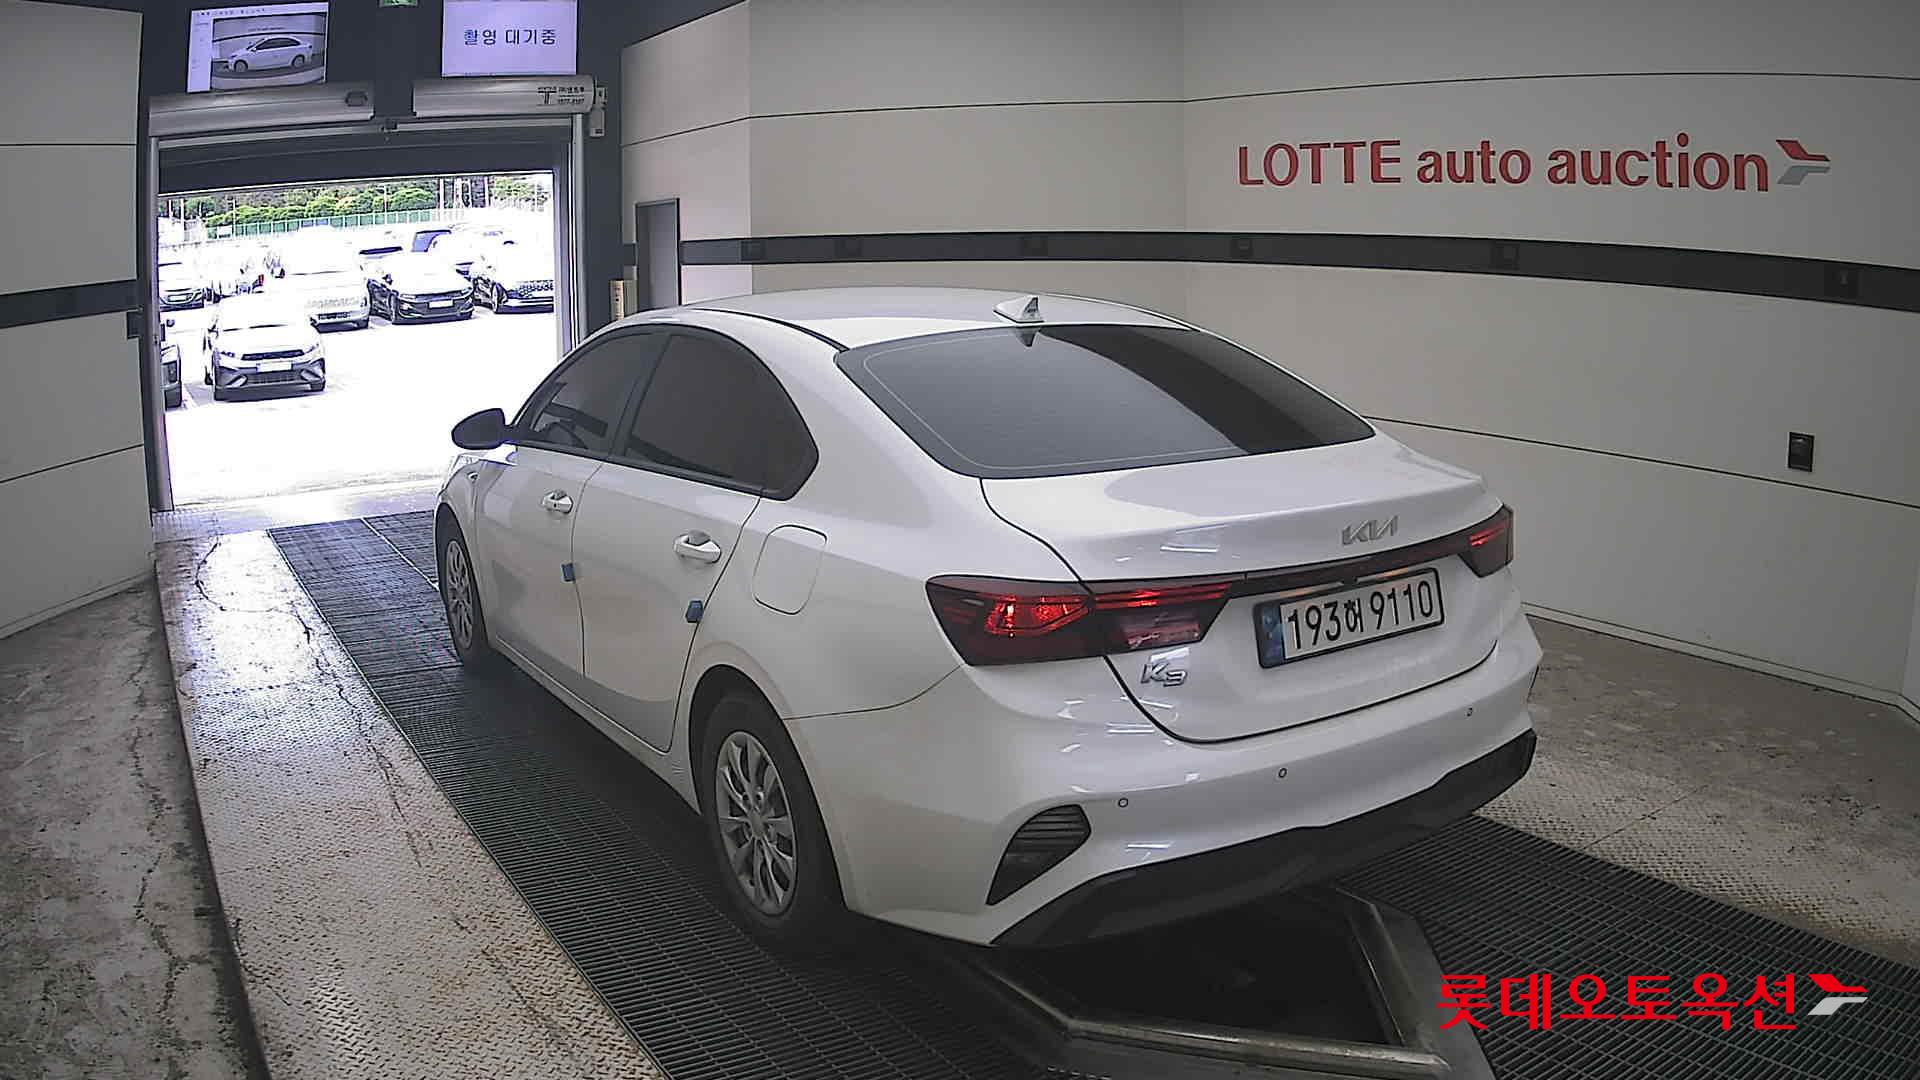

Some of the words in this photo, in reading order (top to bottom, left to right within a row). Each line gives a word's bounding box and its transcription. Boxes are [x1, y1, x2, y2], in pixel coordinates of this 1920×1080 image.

[464, 29, 497, 46] 촬영
[505, 29, 556, 45] 대기중
[1238, 140, 1401, 186] LOTTE
[1417, 140, 1532, 185] auto
[1548, 132, 1769, 192] auction
[1287, 597, 1364, 650] 193허
[1369, 580, 1434, 630] 9110
[1140, 662, 1188, 688] K3
